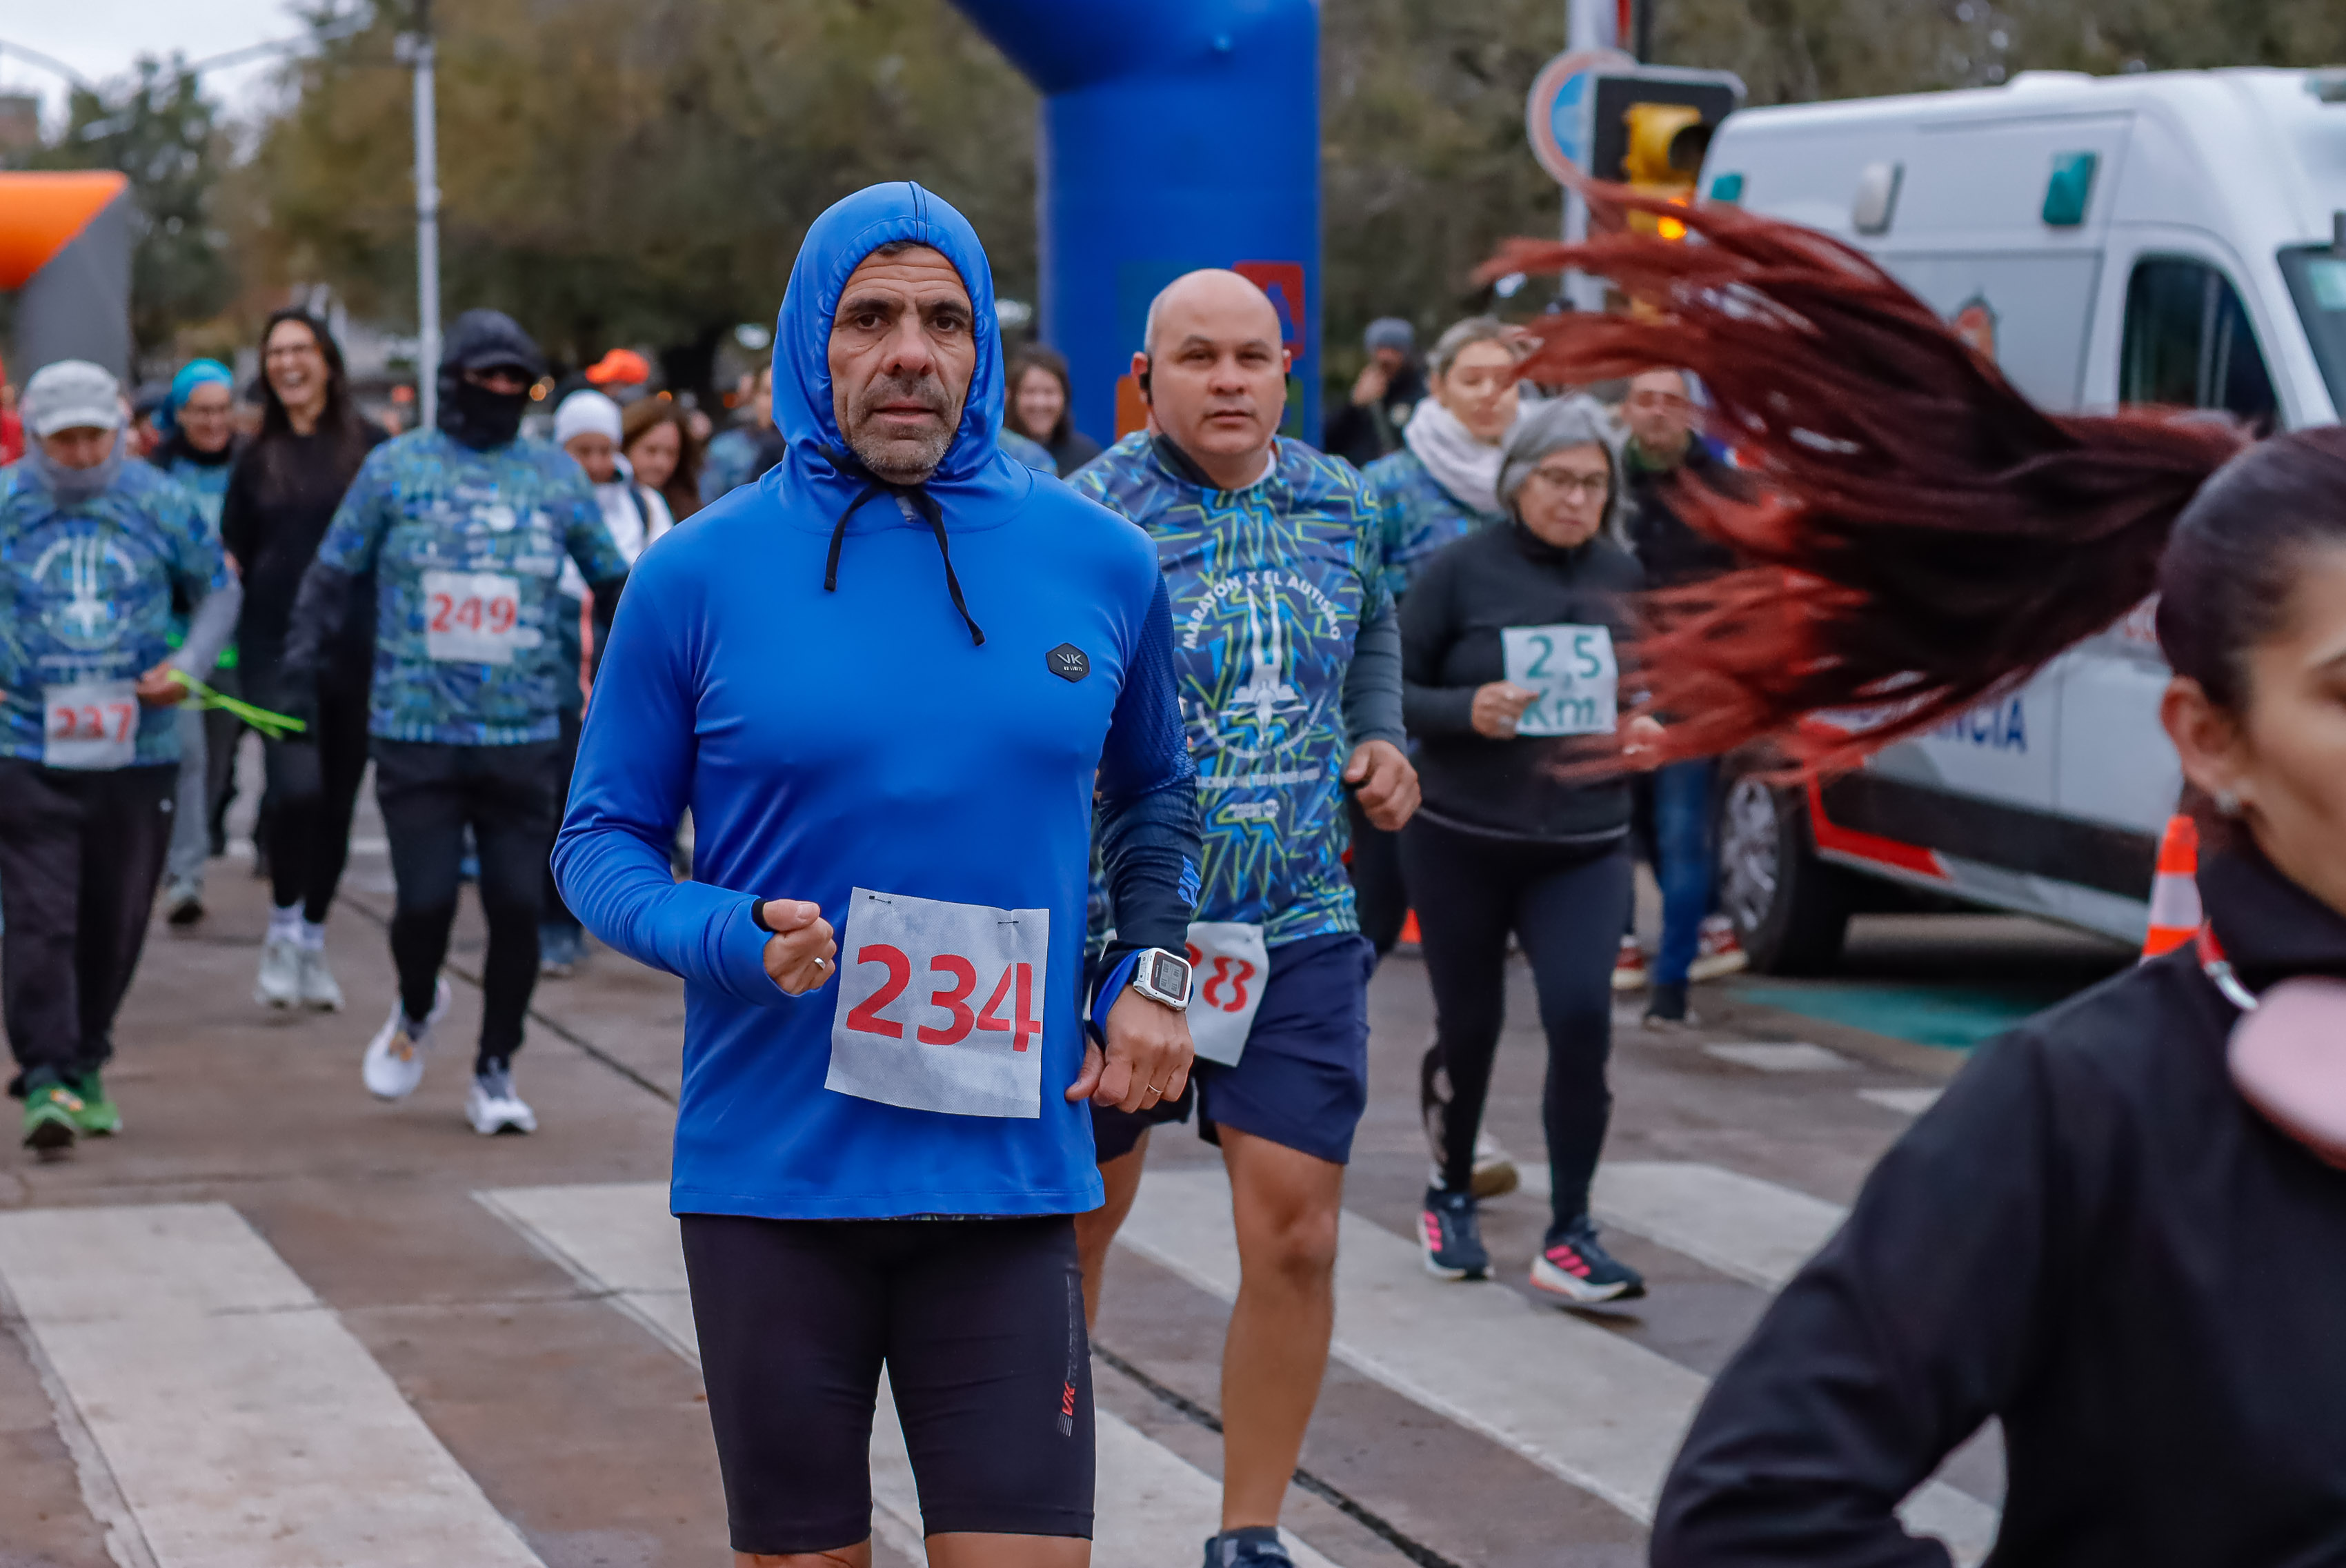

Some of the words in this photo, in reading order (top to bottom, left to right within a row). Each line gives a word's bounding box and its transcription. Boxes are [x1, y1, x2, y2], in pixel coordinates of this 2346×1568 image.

[1246, 571, 1259, 585] X
[431, 593, 516, 634] 249
[1057, 653, 1083, 666] VK
[846, 943, 1041, 1053] 234
